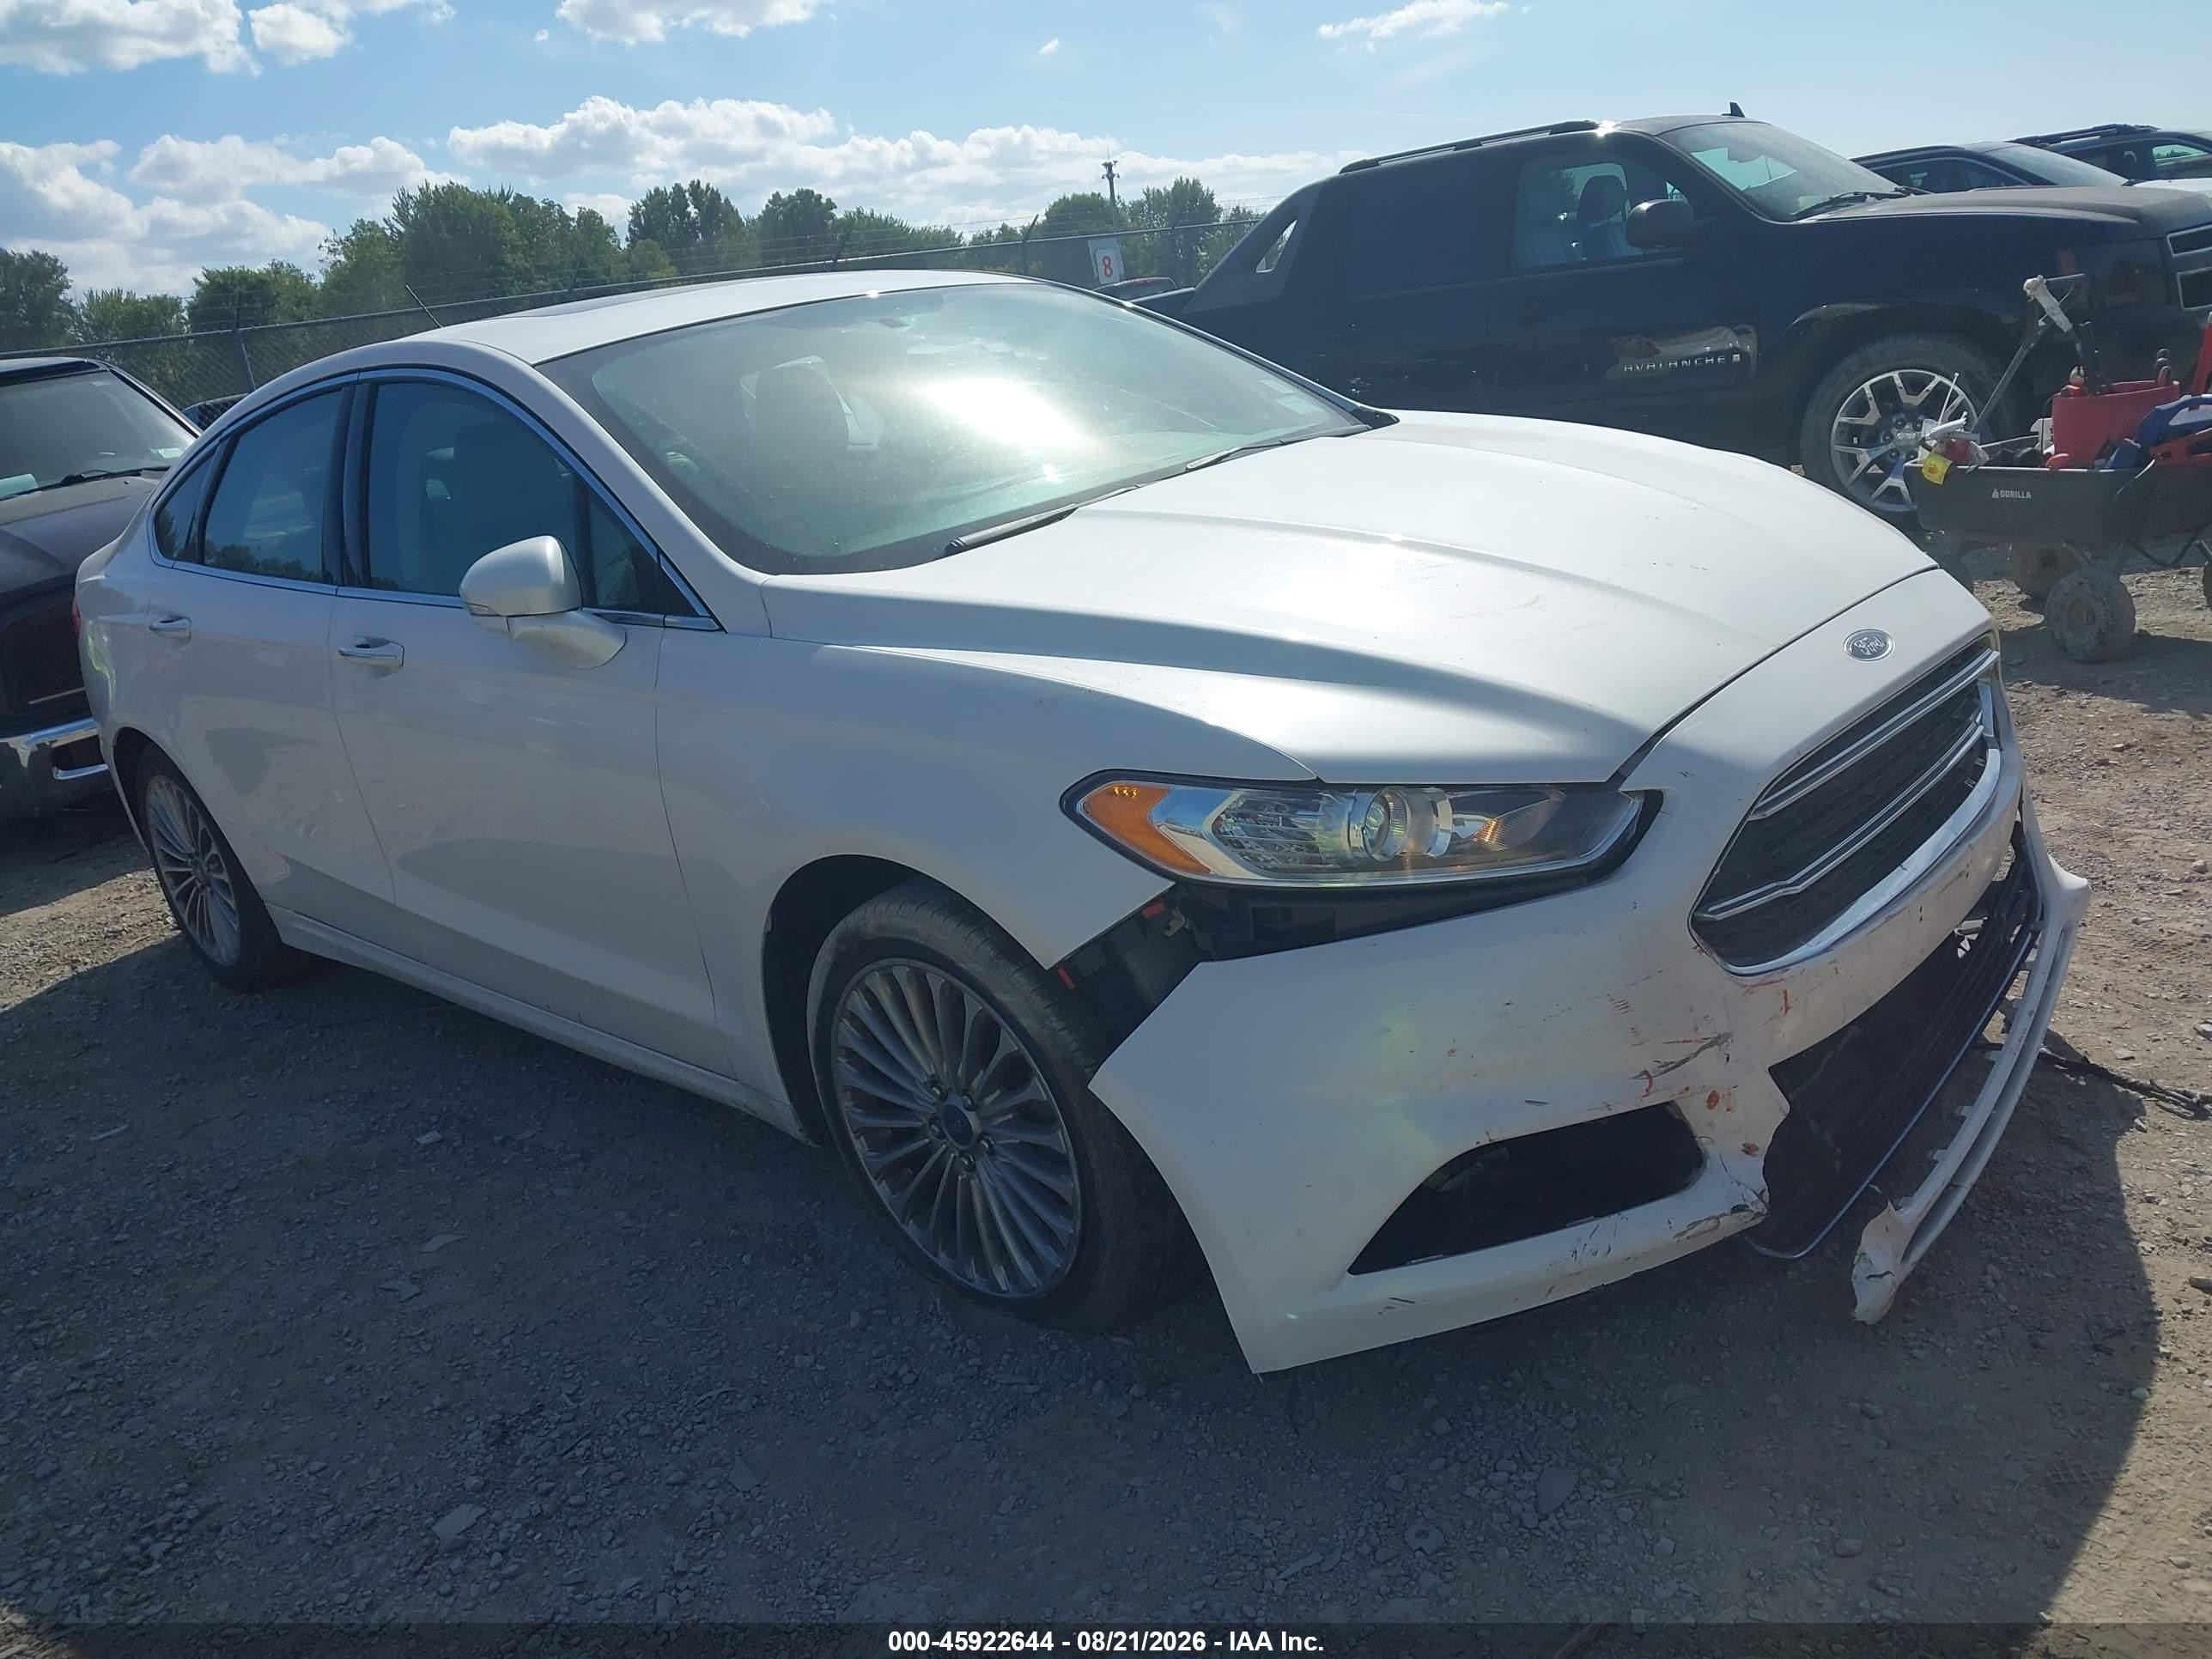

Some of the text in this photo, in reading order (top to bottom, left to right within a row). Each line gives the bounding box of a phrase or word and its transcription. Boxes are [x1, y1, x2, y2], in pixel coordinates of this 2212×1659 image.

[1102, 255, 1114, 278] 8
[1623, 355, 1727, 373] AVALANCHE
[1999, 489, 2032, 499] GORILLA
[1854, 636, 1886, 656] Ford
